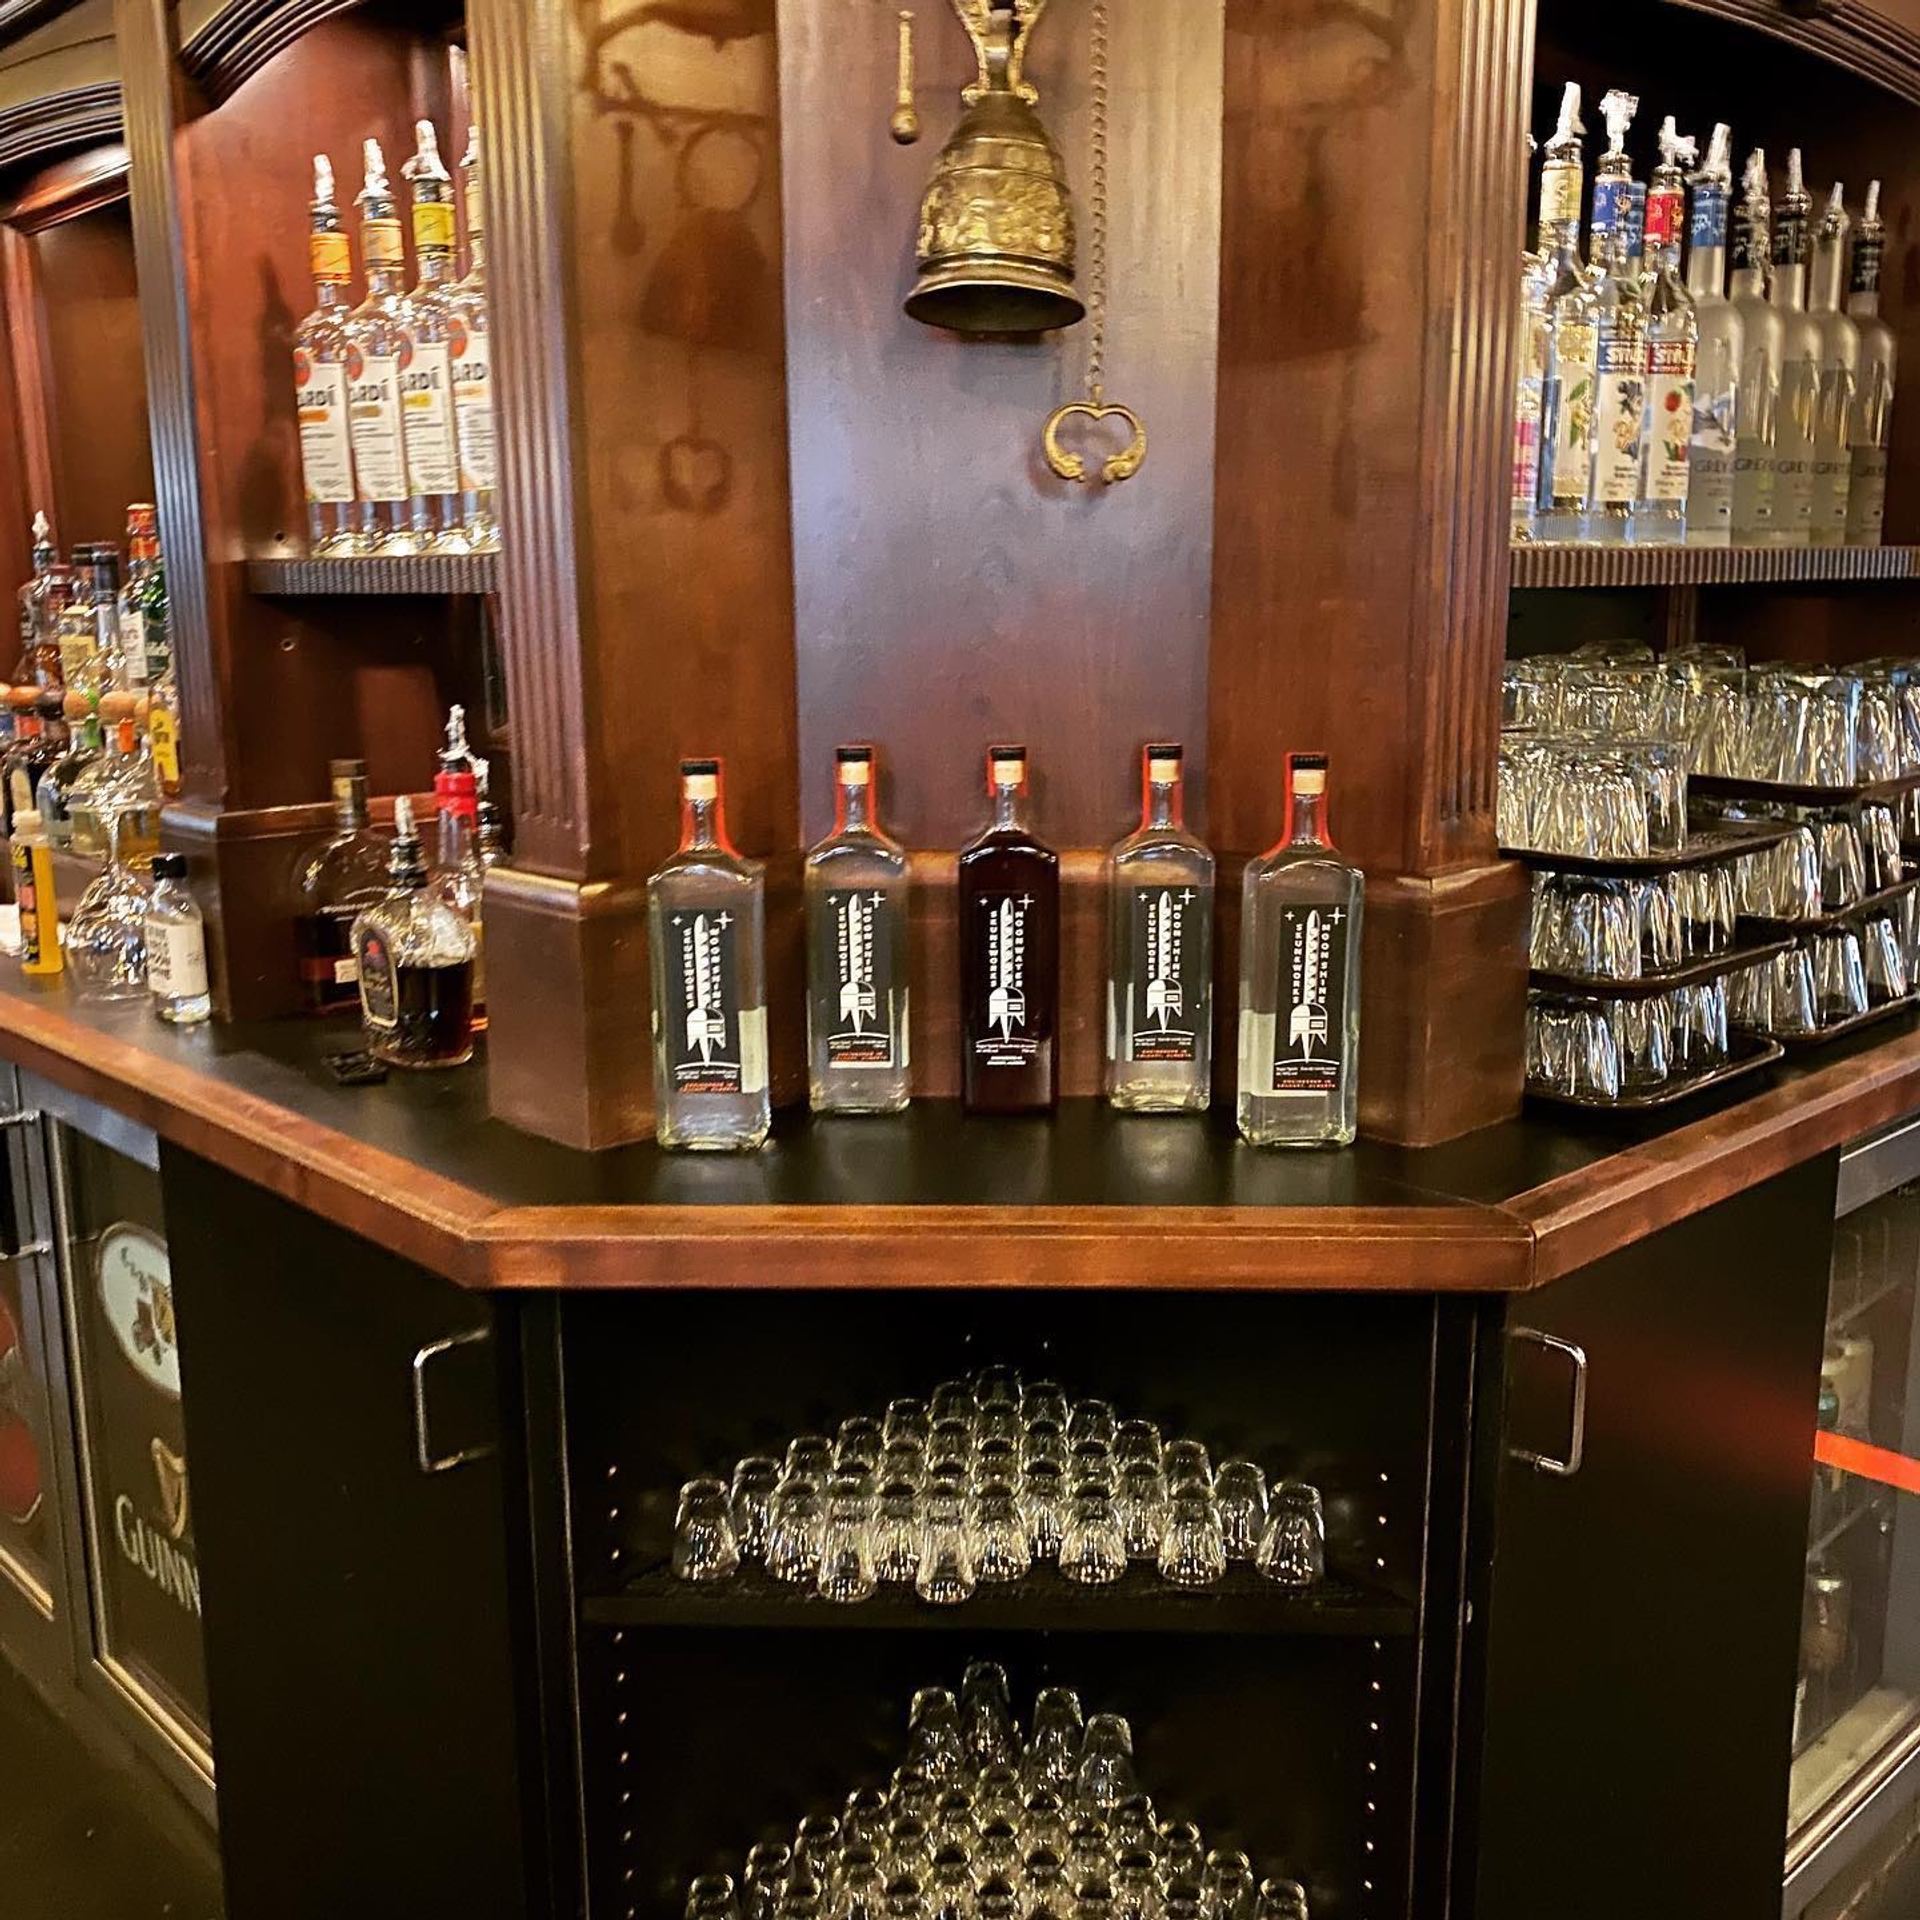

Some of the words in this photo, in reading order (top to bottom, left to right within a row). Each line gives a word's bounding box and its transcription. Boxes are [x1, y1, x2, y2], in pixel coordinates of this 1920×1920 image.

[838, 907, 848, 983] SKUNKWORKS
[863, 907, 873, 982] MOONSHINE
[989, 911, 998, 988] SKUNKWORKS
[1015, 911, 1025, 987] MOONWATER
[1147, 904, 1157, 979] SKUNKWORKS
[1172, 904, 1182, 979] MOONSHINE
[1292, 924, 1303, 1004] SKUNKWORKS
[1318, 924, 1330, 1004] MOONSHINE
